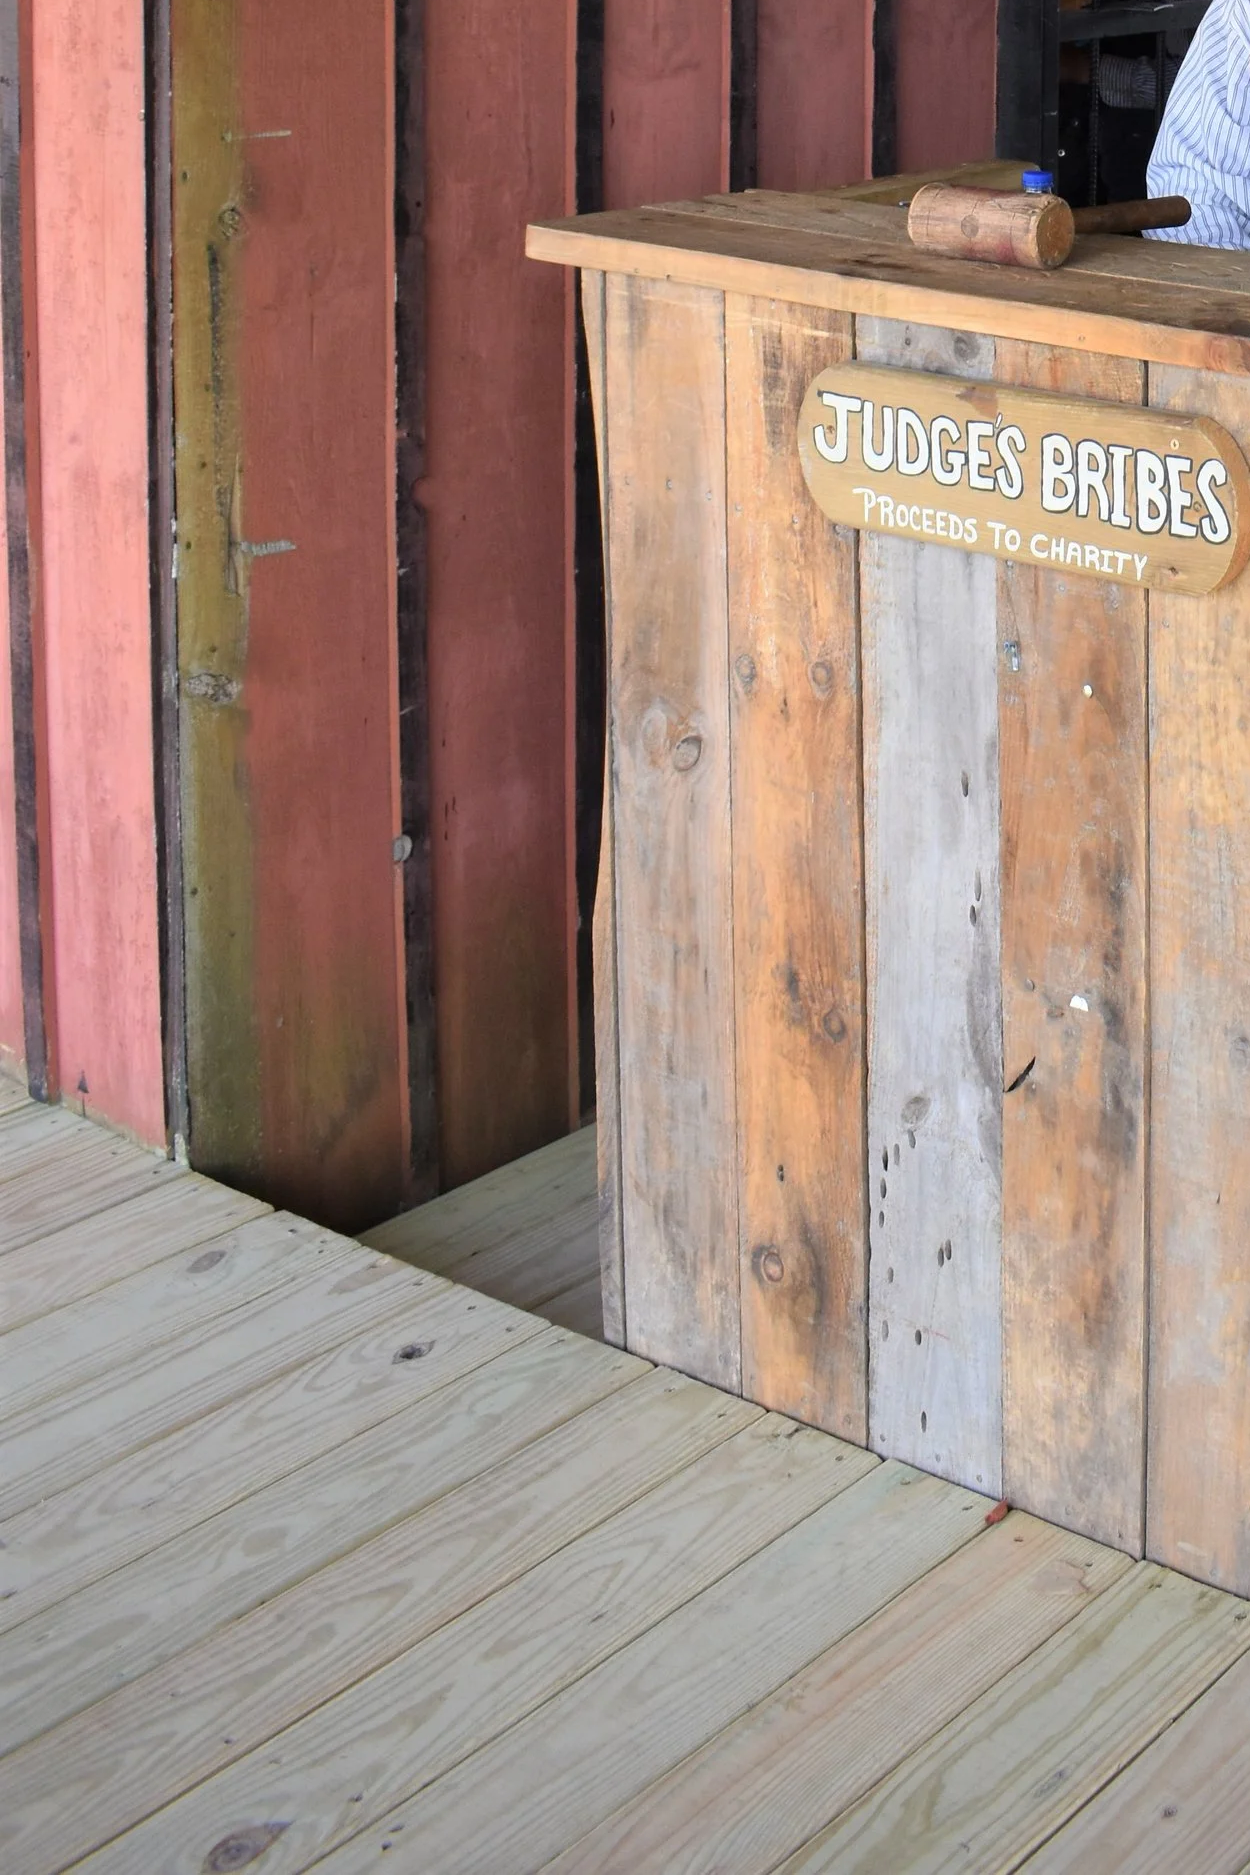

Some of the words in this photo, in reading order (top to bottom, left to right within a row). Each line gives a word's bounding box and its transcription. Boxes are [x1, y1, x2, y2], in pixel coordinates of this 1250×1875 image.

[813, 389, 1027, 501] JUDGE'S
[1040, 433, 1230, 545] BRIBES
[852, 487, 979, 544] PROCEEDS
[986, 520, 1021, 553] TO
[1029, 533, 1149, 582] CHARITY
